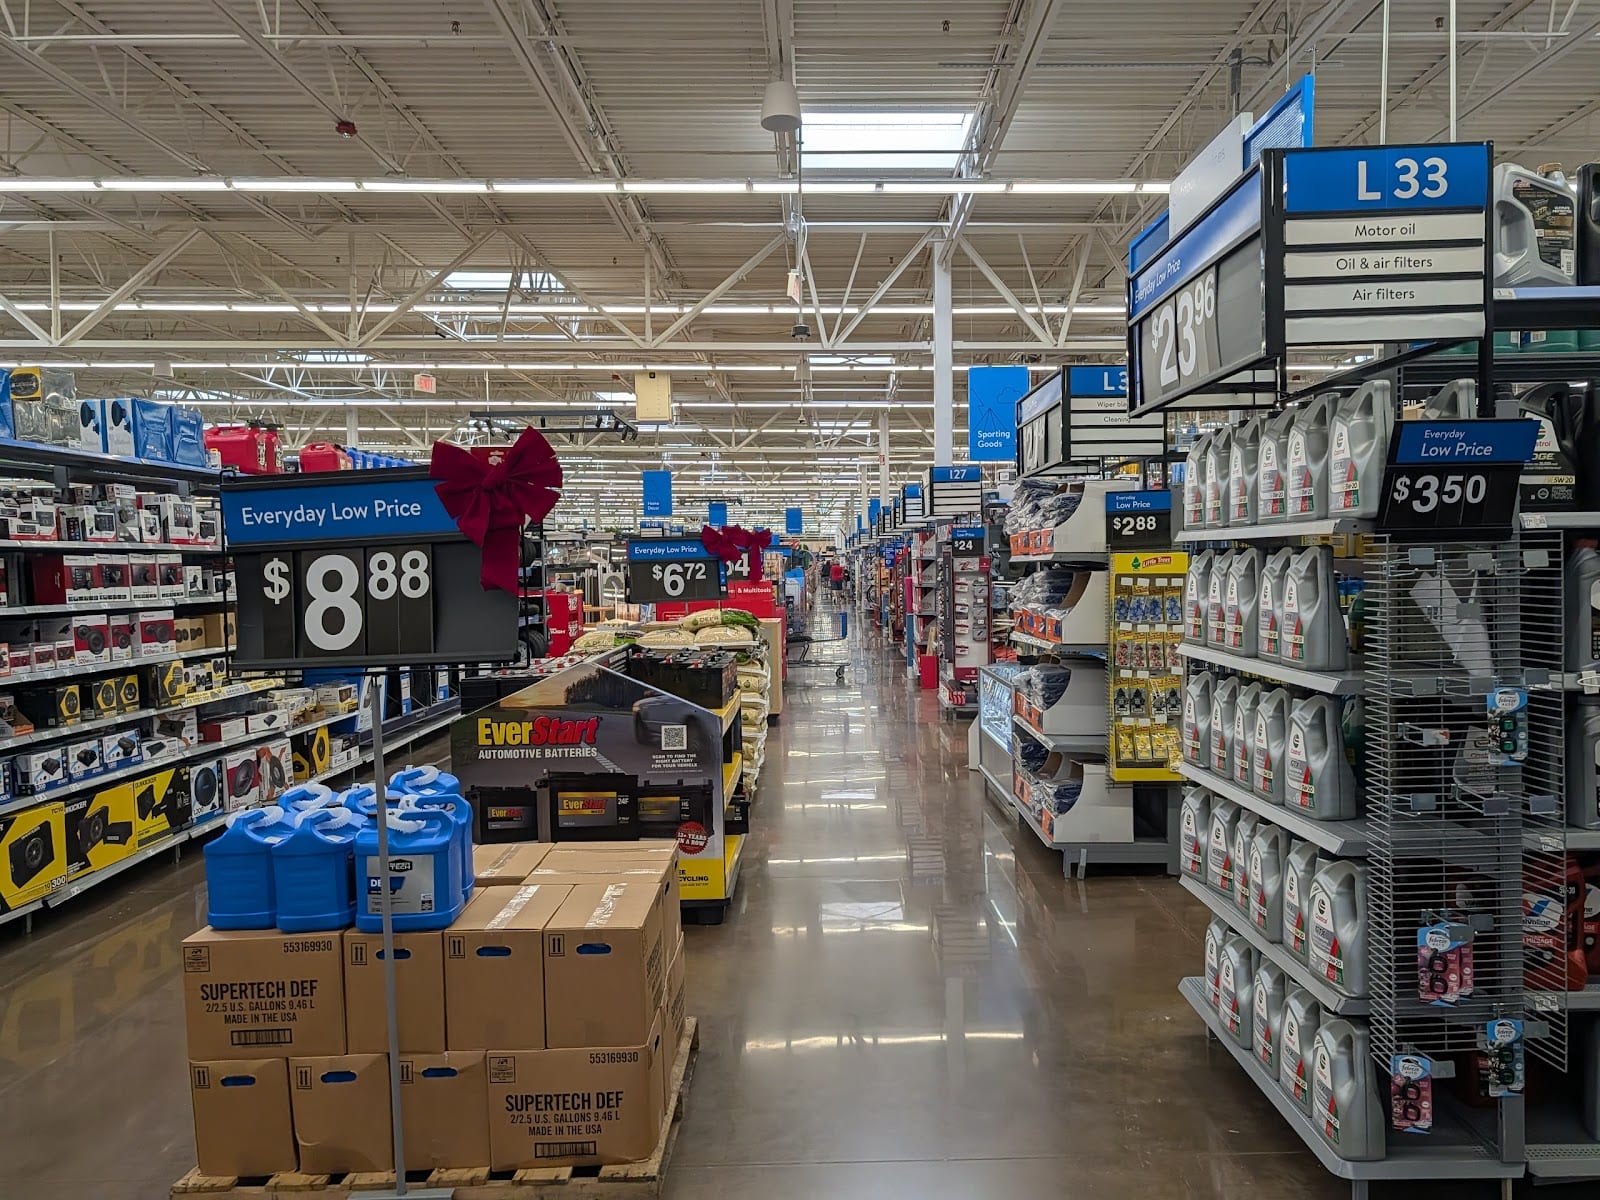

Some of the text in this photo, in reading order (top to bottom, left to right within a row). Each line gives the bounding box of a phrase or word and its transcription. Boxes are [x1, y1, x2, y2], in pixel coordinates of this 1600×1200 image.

[1358, 157, 1448, 200] L 33
[1355, 223, 1416, 237] Motor oil
[1336, 256, 1432, 270] Oil & air filters
[1135, 259, 1181, 304] Everyday Low Price
[1352, 288, 1414, 301] Air filters
[1104, 371, 1128, 390] L 3
[1097, 401, 1116, 409] Wiper
[1104, 416, 1131, 424] Cleaning
[978, 430, 1010, 439] Sporting
[1424, 430, 1465, 440] Everyday
[978, 440, 1002, 448] Goods
[1420, 443, 1493, 456] Low Price
[1532, 452, 1556, 460] DGE
[242, 499, 422, 528] Everyday Low Price
[634, 546, 666, 555] Everyday
[681, 545, 698, 553] Price
[477, 716, 600, 746] EverStart
[478, 748, 598, 760] AUTOMOTIVE BATTERIES
[52, 876, 66, 888] 300
[370, 879, 382, 887] DE
[284, 940, 332, 952] 553169930
[200, 980, 318, 1000] SUPERTECH DEF
[206, 1000, 315, 1013] 2/2.5 U.S. GALLONS 9.46 L
[224, 1012, 297, 1024] MADE IN THE USA
[590, 1052, 638, 1064] 553169930
[506, 1091, 624, 1112] SUPERTECH DEF
[510, 1111, 620, 1124] 2/2.5 U.S. GALLONS 9.46 L
[528, 1124, 602, 1136] MADE IN THE USA
